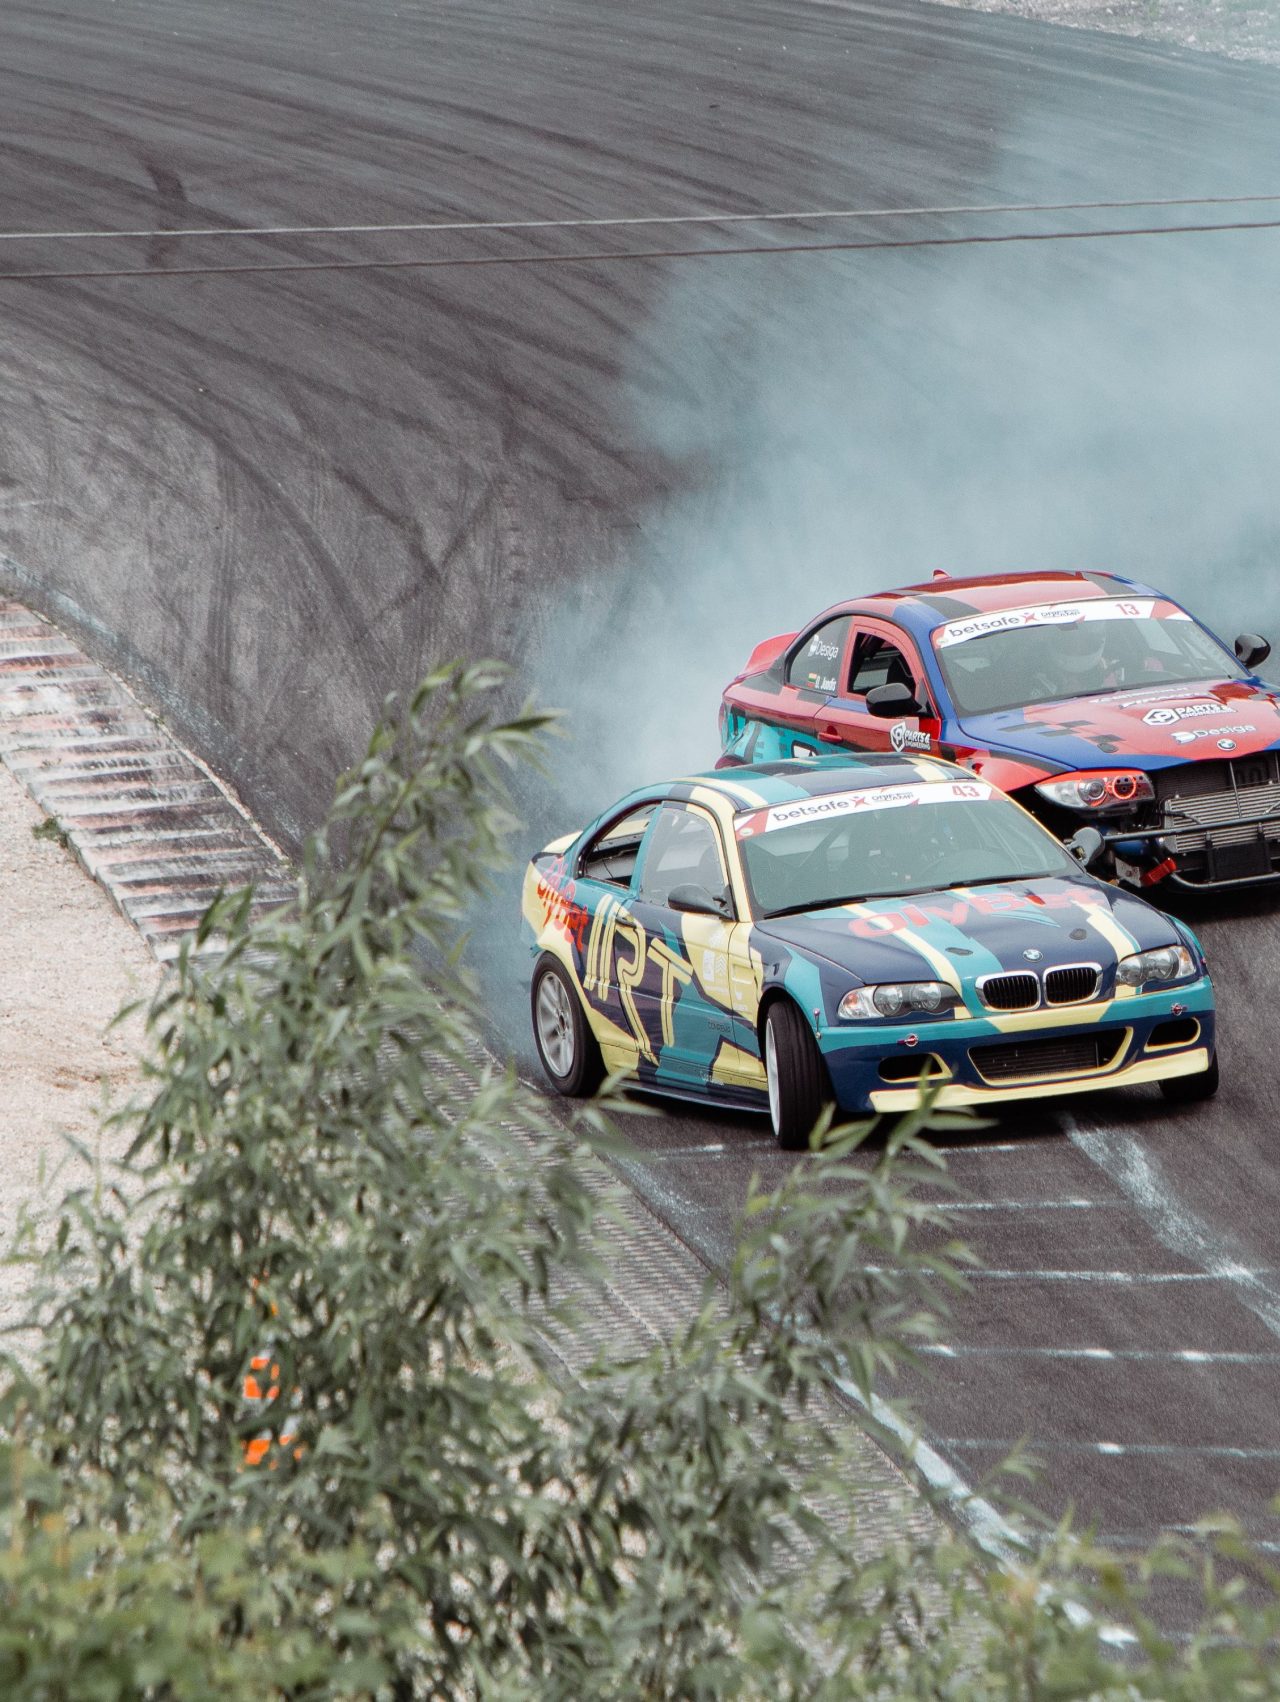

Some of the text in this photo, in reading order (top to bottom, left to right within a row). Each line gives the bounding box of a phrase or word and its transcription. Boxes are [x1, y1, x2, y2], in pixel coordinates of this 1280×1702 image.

[1115, 603, 1141, 616] 13
[949, 613, 1021, 638] betsafe
[816, 640, 839, 661] Desiga
[1175, 703, 1221, 715] PARTS
[904, 731, 926, 743] PARTS
[1195, 724, 1257, 738] Desiga
[951, 784, 981, 798] 43
[773, 800, 850, 822] betsafe
